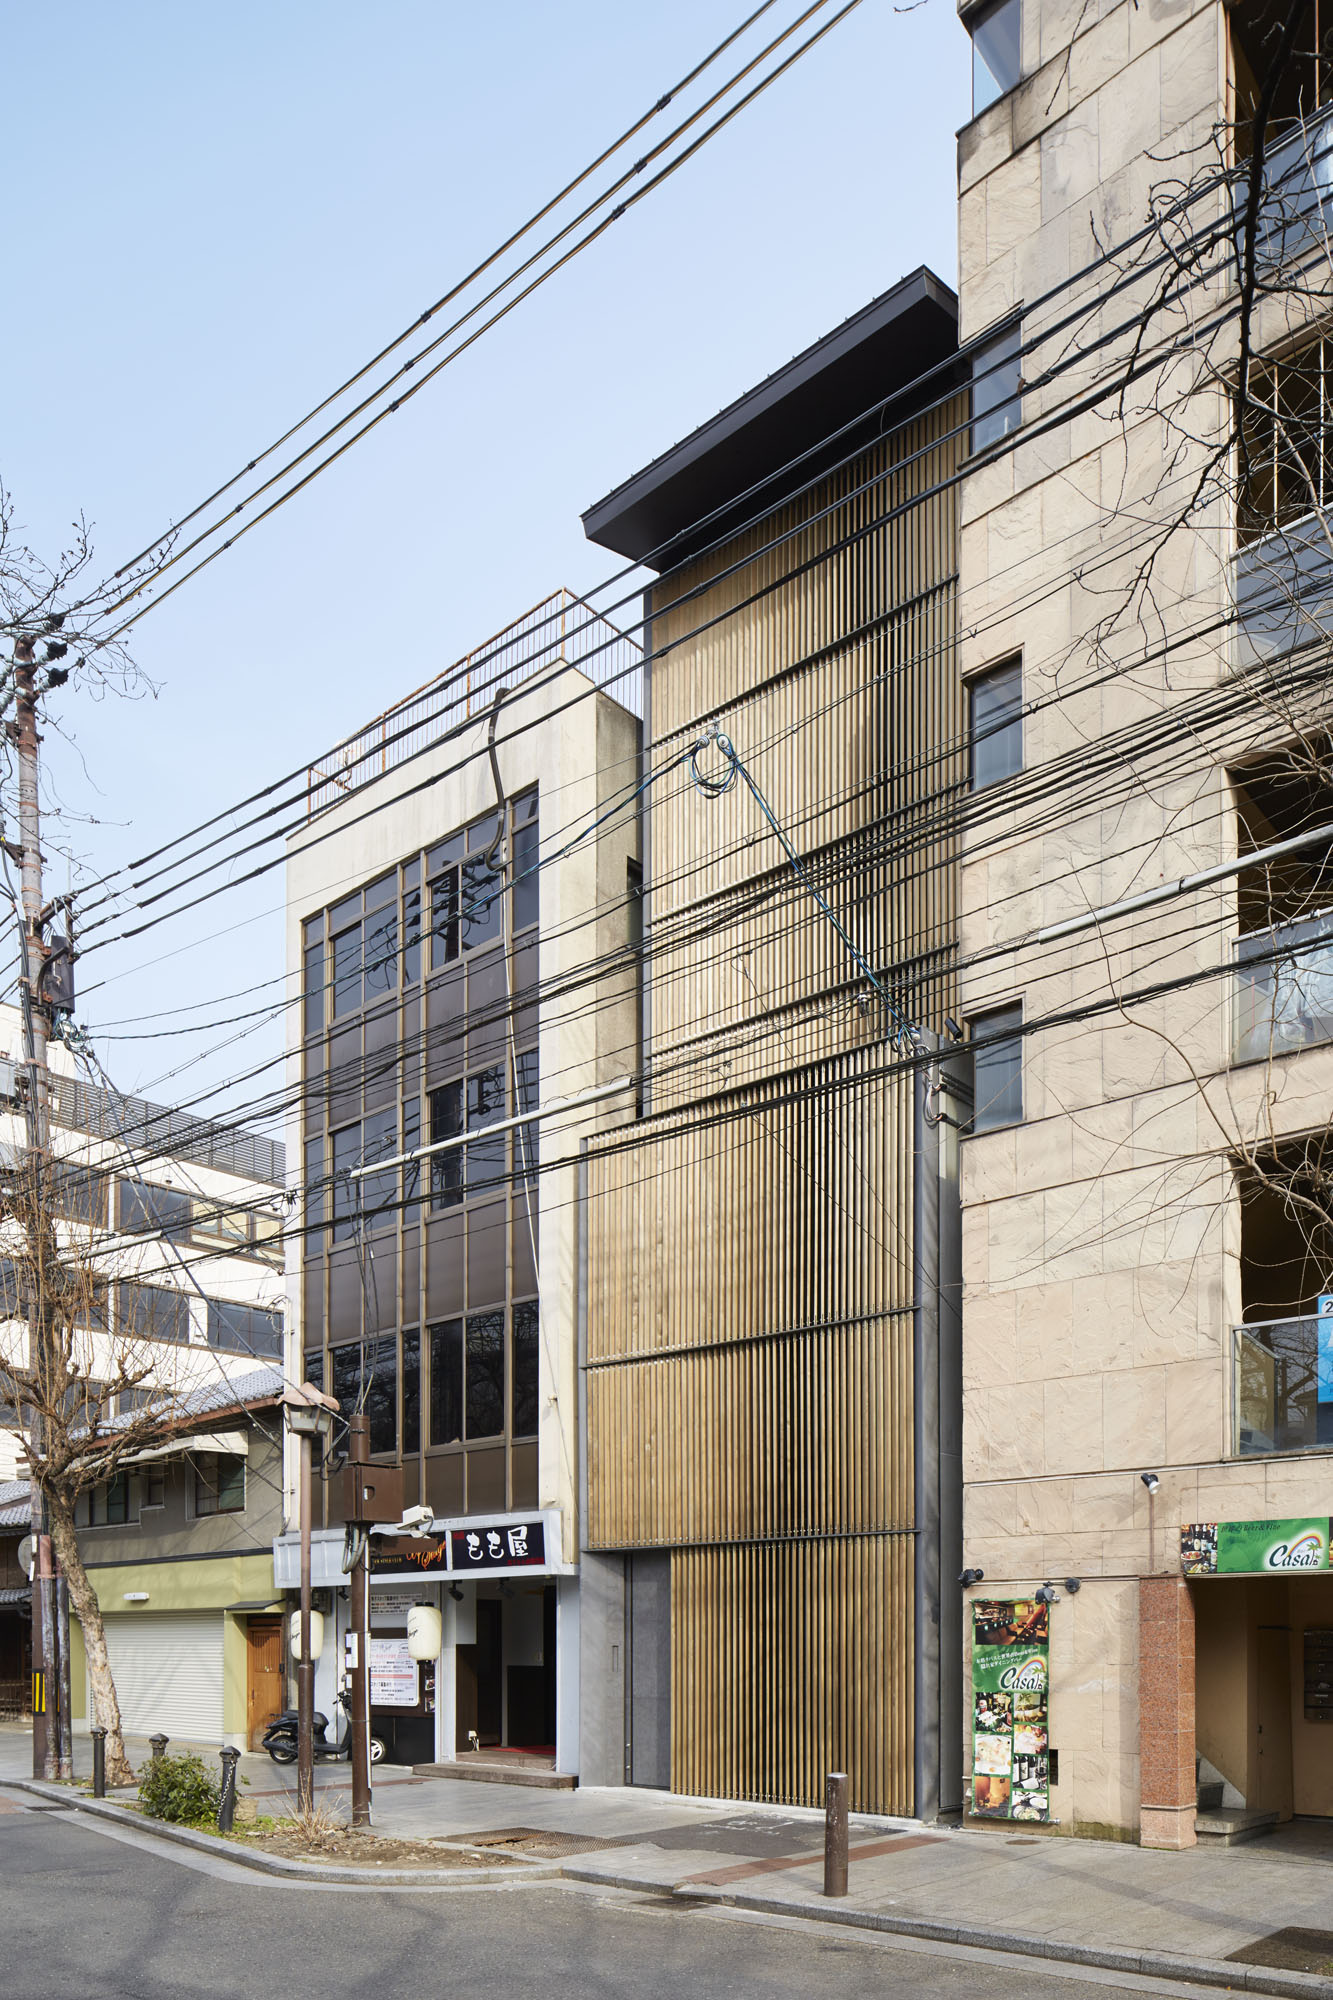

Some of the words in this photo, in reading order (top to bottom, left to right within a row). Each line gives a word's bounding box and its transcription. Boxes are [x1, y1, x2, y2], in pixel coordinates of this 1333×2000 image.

[466, 1525, 529, 1561] もも屋
[1268, 1544, 1311, 1567] Casa
[1001, 1666, 1036, 1689] Casa
